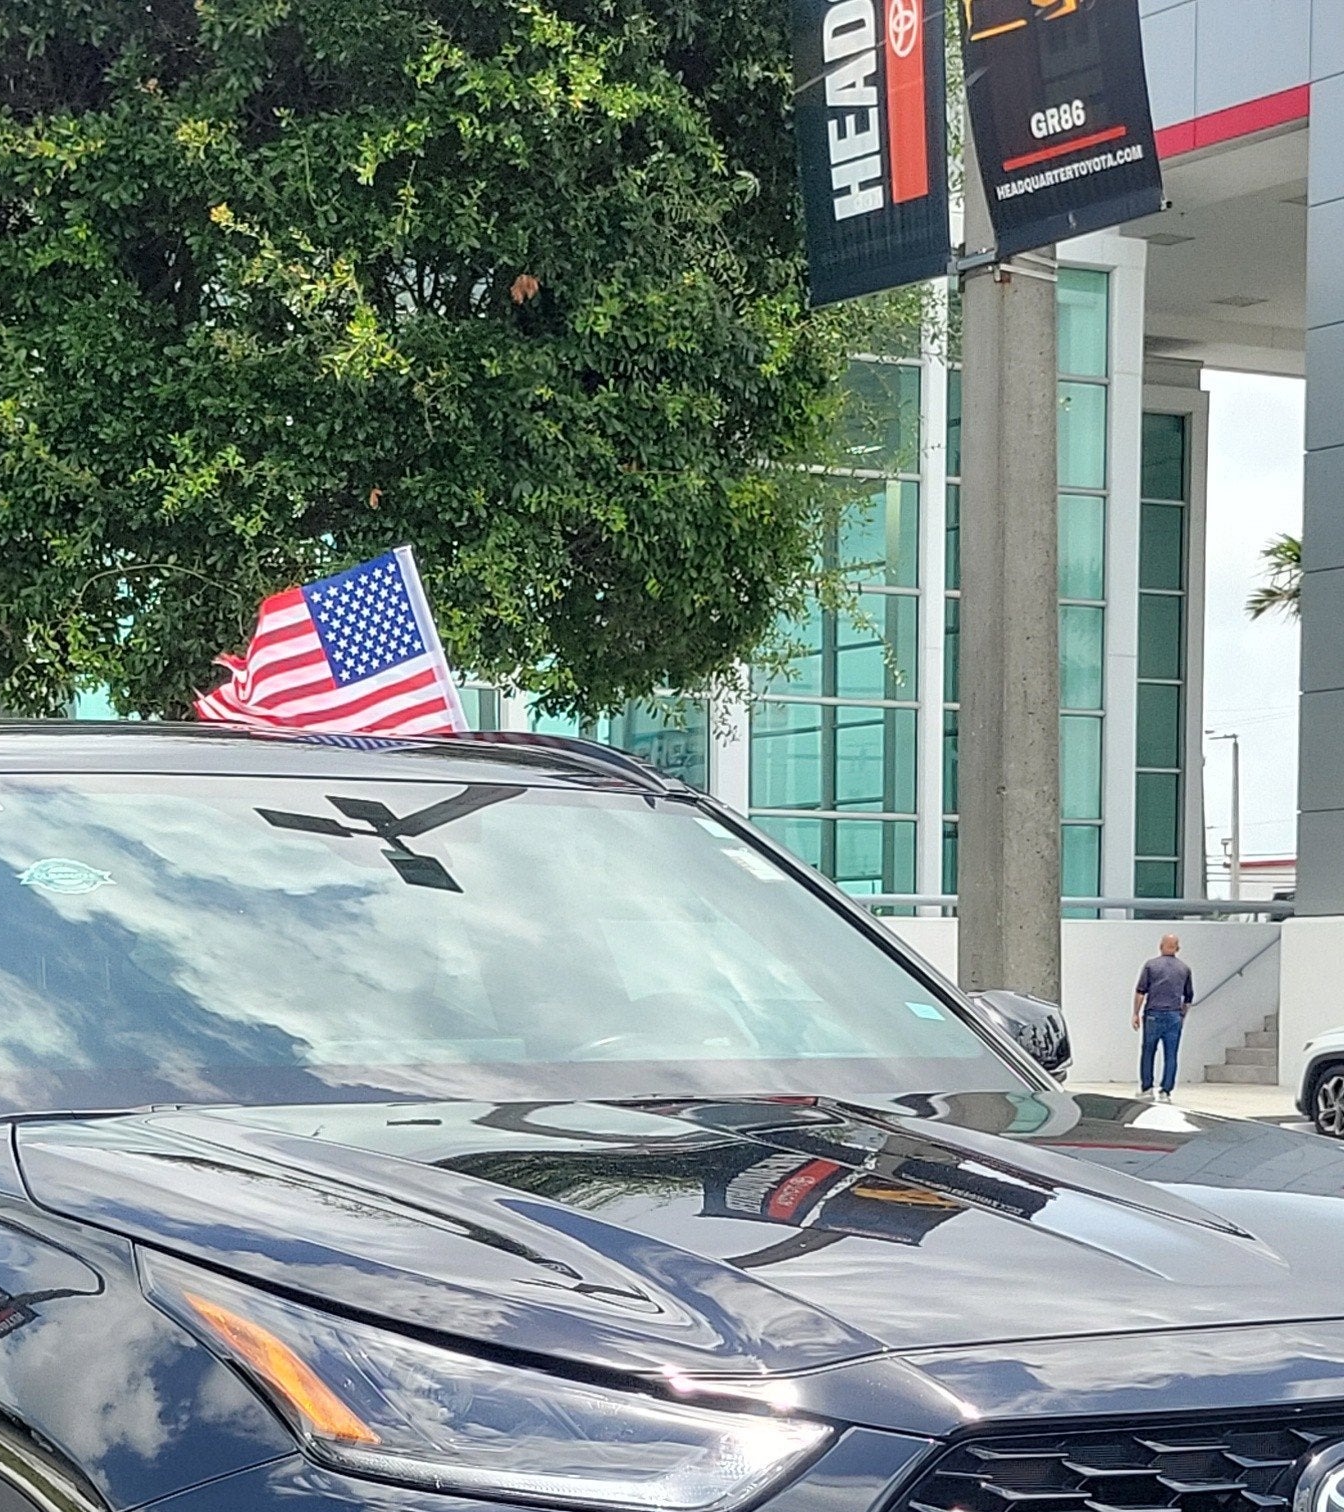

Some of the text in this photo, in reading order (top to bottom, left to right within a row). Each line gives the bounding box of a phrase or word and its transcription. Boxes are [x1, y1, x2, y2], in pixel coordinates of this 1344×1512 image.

[823, 0, 884, 221] HEAD
[1030, 99, 1086, 139] GR86
[996, 144, 1145, 201] HEADQUARTERTOYOTA.COM
